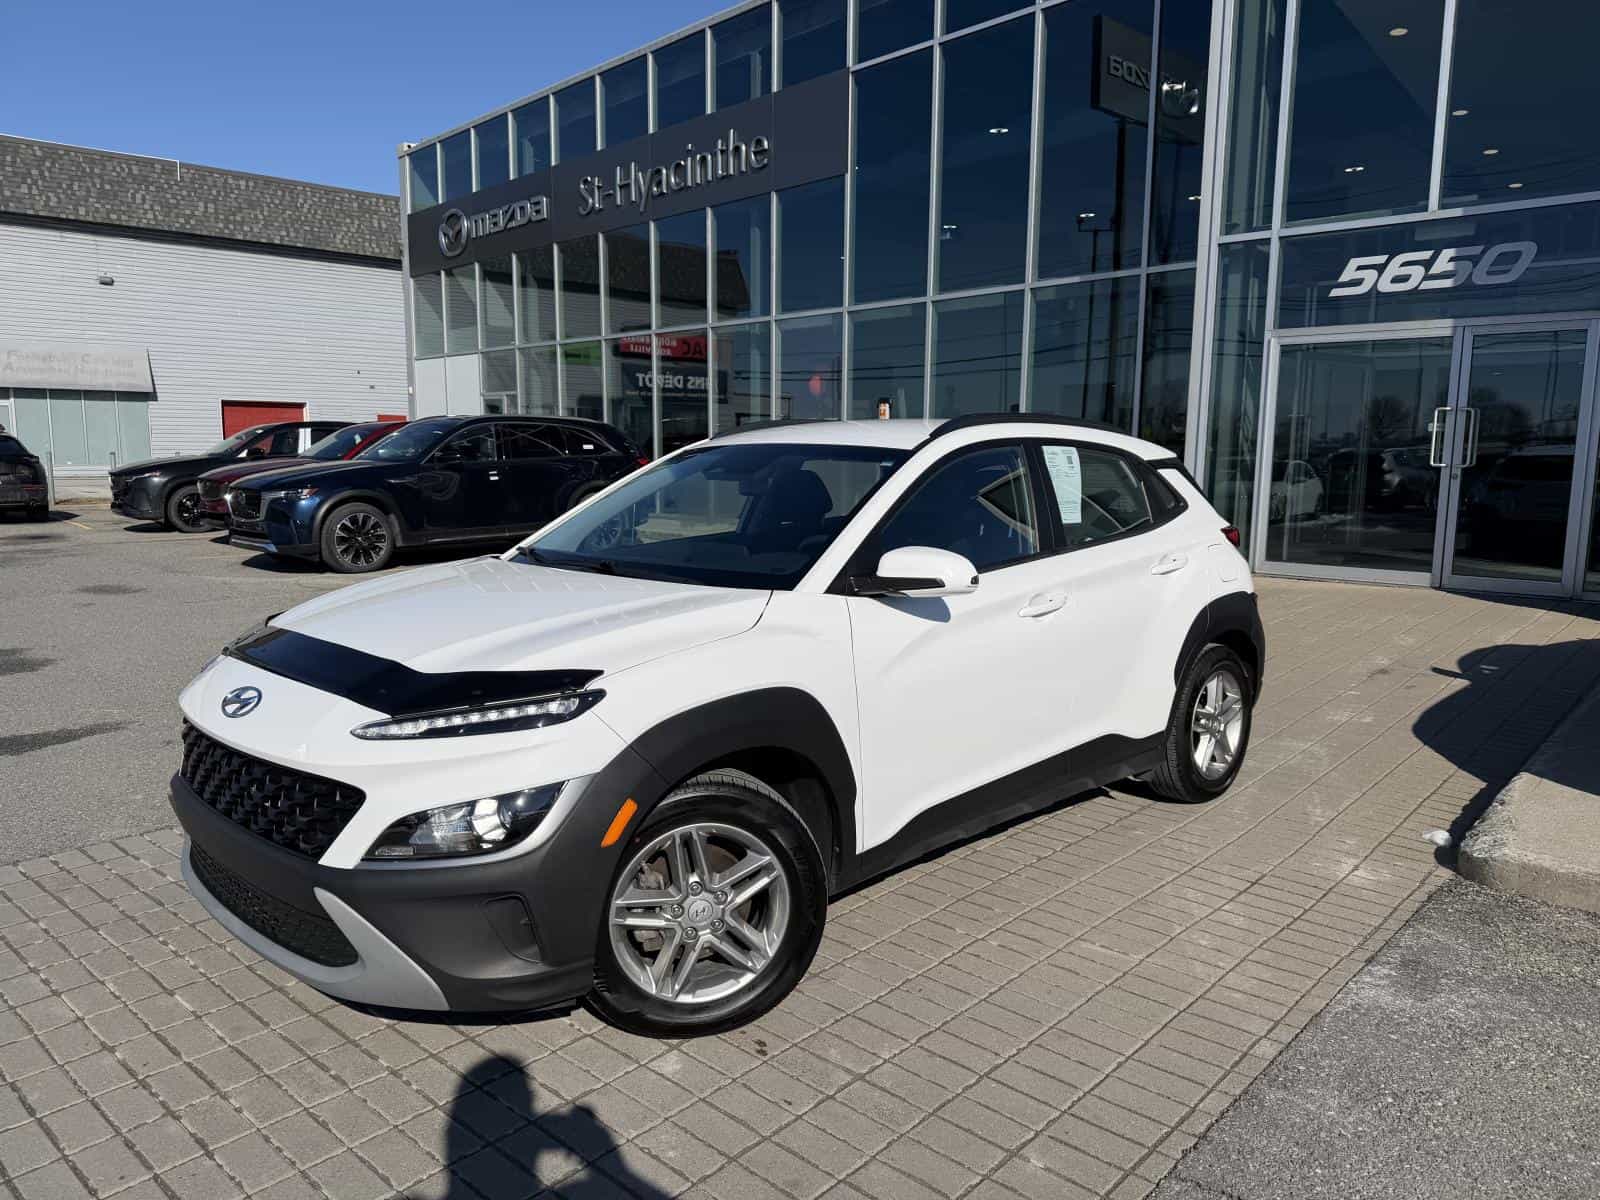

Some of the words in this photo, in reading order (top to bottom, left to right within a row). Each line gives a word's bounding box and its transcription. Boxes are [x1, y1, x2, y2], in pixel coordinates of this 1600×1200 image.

[578, 128, 769, 216] St-Hyacinthe
[470, 195, 548, 239] mazda
[1328, 241, 1538, 297] 5650
